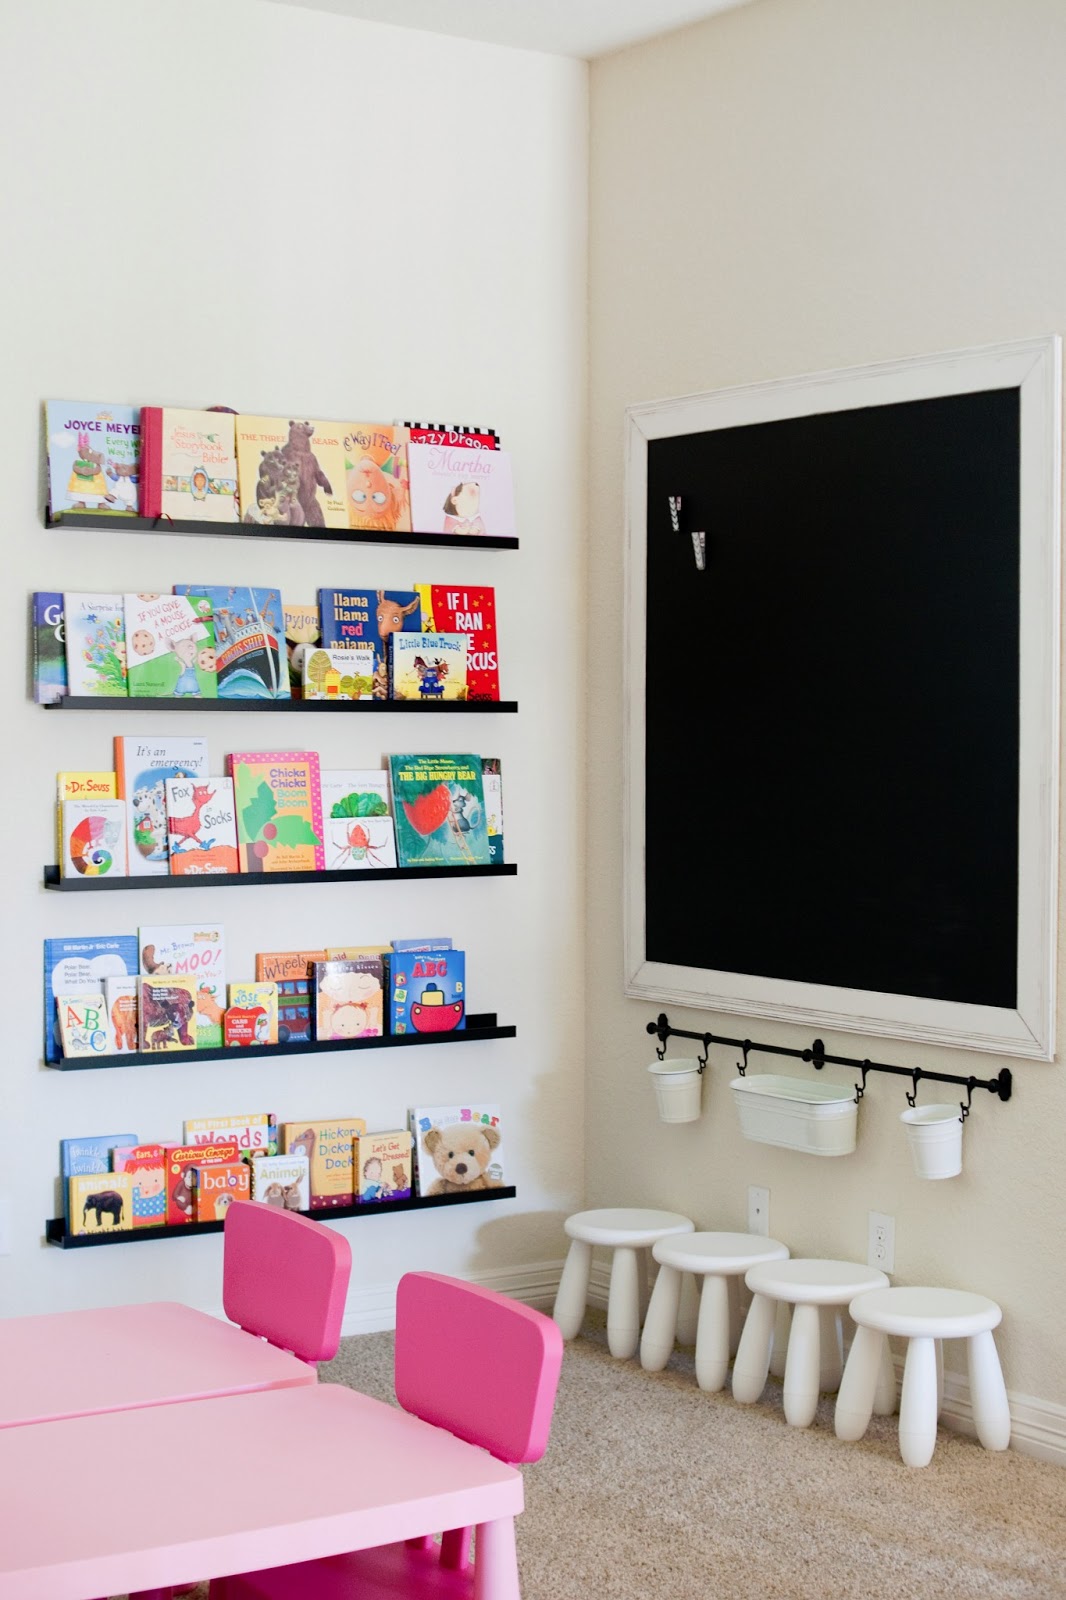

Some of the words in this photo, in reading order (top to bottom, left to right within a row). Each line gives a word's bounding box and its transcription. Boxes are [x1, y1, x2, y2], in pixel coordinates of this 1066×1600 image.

[64, 420, 102, 432] JOYCE
[106, 423, 141, 435] MEYE
[170, 429, 196, 441] Jesus
[106, 436, 129, 448] Every
[240, 433, 257, 441] THE
[312, 437, 340, 446] BEARS
[352, 431, 372, 450] Way
[373, 433, 378, 446] I
[378, 435, 402, 456] Feel
[410, 431, 446, 445] izzy
[108, 447, 126, 458] Way
[175, 438, 224, 454] Storybook
[202, 452, 229, 464] Bible
[427, 447, 496, 474] Martha
[333, 593, 369, 608] llama
[447, 593, 460, 610] IF
[463, 593, 469, 611] I
[137, 611, 146, 623] IF
[147, 605, 161, 618] YOU
[162, 599, 181, 613] GIVE
[333, 607, 369, 622] llama
[154, 619, 160, 628] A
[160, 610, 186, 626] MOUSE
[455, 612, 483, 631] RAN
[158, 632, 164, 640] A
[165, 619, 193, 637] COOKIE
[341, 624, 364, 637] red
[242, 634, 264, 649] SHIP
[399, 638, 420, 650] Little
[422, 637, 438, 649] Blue
[439, 637, 462, 652] Truck
[332, 653, 356, 662] Rosie's
[356, 653, 371, 662] Walk
[466, 653, 498, 671] RCUS
[137, 746, 150, 757] It's
[153, 749, 167, 757] an
[150, 757, 204, 771] emergency!
[270, 768, 306, 778] Chicka
[398, 772, 414, 781] THE
[415, 772, 428, 781] BIG
[429, 771, 456, 781] HUNGRY
[457, 771, 476, 781] BEAR
[71, 782, 86, 794] Dr.
[86, 780, 110, 793] Seuss
[270, 778, 307, 788] Chicka
[172, 786, 191, 803] Fox
[277, 788, 307, 798] Boom
[278, 798, 308, 808] Boom
[203, 810, 233, 830] Socks
[171, 942, 195, 951] Brown
[175, 949, 222, 974] MOO!
[264, 954, 306, 979] Wheels
[356, 963, 379, 971] kisses
[412, 960, 448, 978] ABC
[455, 982, 463, 993] B
[234, 992, 258, 1005] NOSE
[66, 1006, 84, 1029] A
[83, 1009, 100, 1031] B
[90, 1031, 107, 1052] C
[418, 1116, 432, 1132] B
[460, 1108, 500, 1127] Bear
[319, 1126, 361, 1141] Hickory
[136, 1149, 153, 1159] Ears,
[171, 1148, 204, 1163] Curious
[204, 1146, 235, 1161] George
[372, 1143, 387, 1154] Let's
[387, 1142, 400, 1152] Get
[203, 1168, 250, 1192] baby
[260, 1166, 307, 1180] Animals
[79, 1177, 128, 1192] animals
